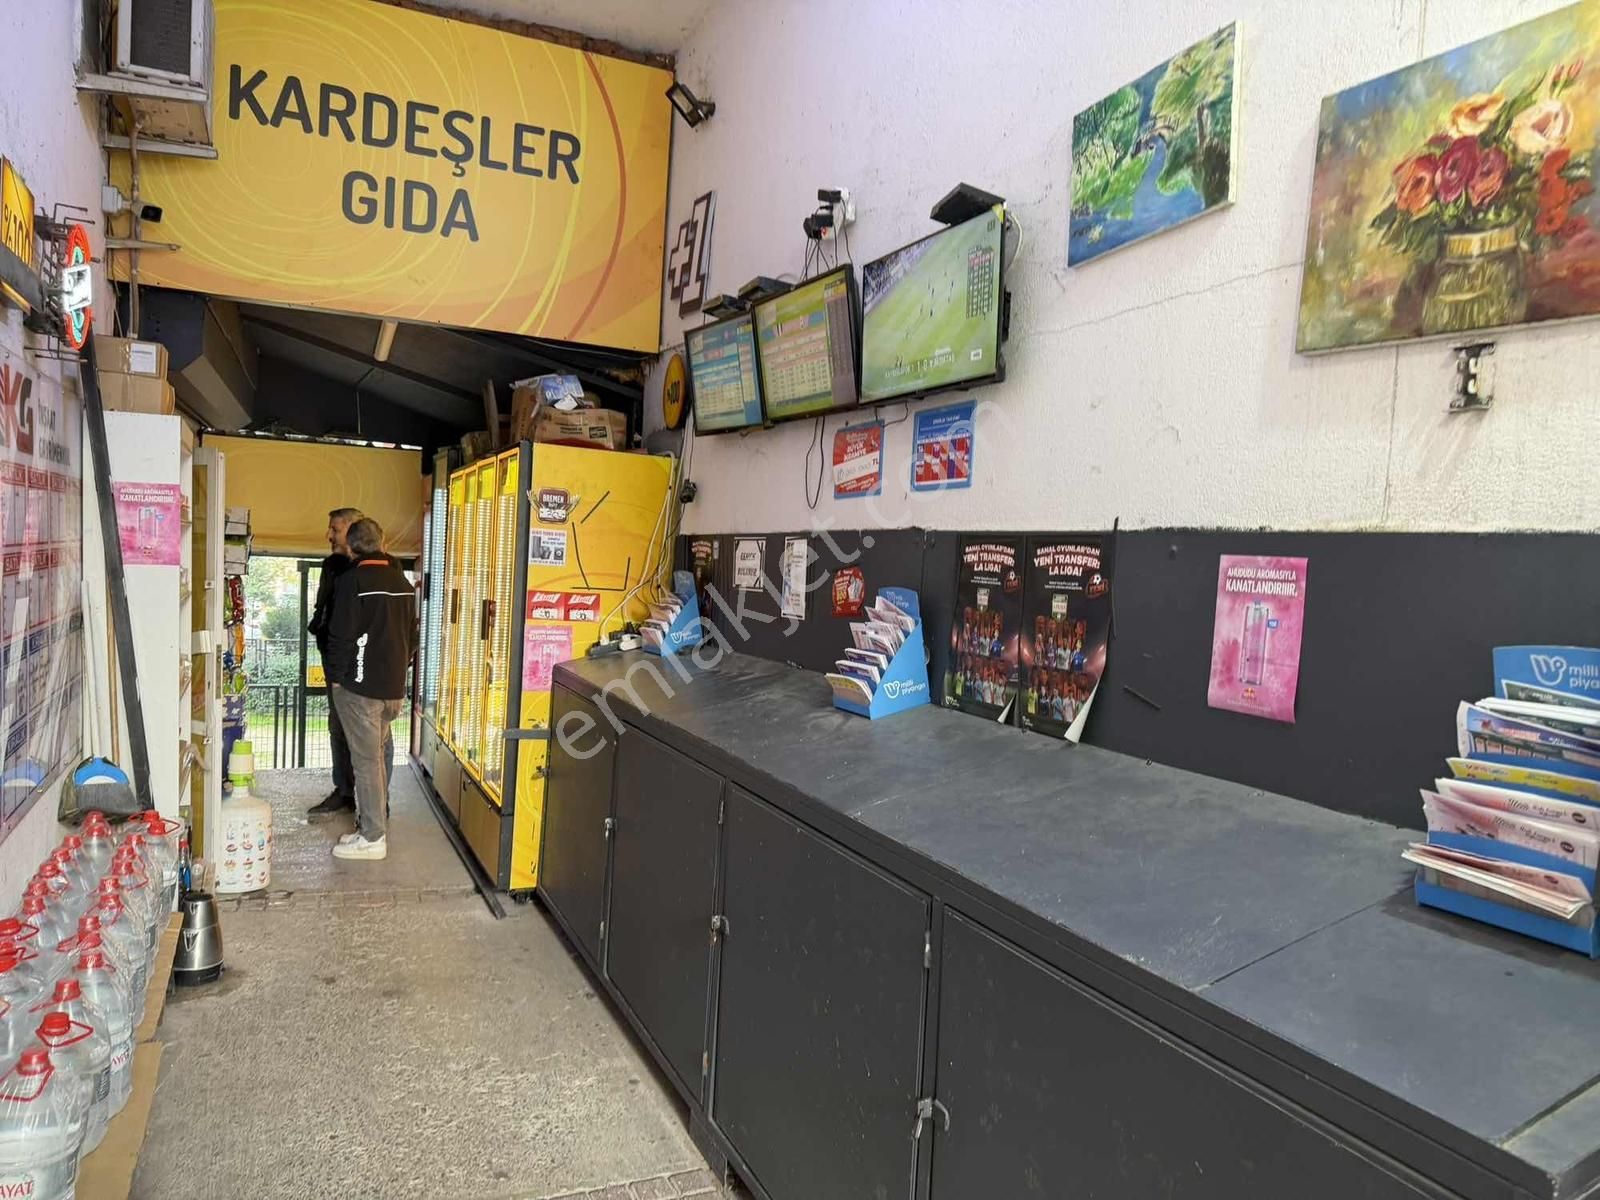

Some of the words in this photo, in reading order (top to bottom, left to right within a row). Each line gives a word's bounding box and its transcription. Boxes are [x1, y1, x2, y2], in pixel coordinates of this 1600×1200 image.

[228, 64, 582, 184] KARDEŞLER
[341, 171, 480, 242] GIDA
[963, 551, 979, 564] YENİ
[1034, 552, 1053, 567] YENİ
[973, 563, 983, 572] LA
[1049, 565, 1059, 576] LA
[1060, 565, 1083, 577] LIGA!
[1227, 567, 1256, 578] AHUDUDU
[1256, 568, 1297, 581] AROMASIYLA
[1569, 664, 1599, 677] milli
